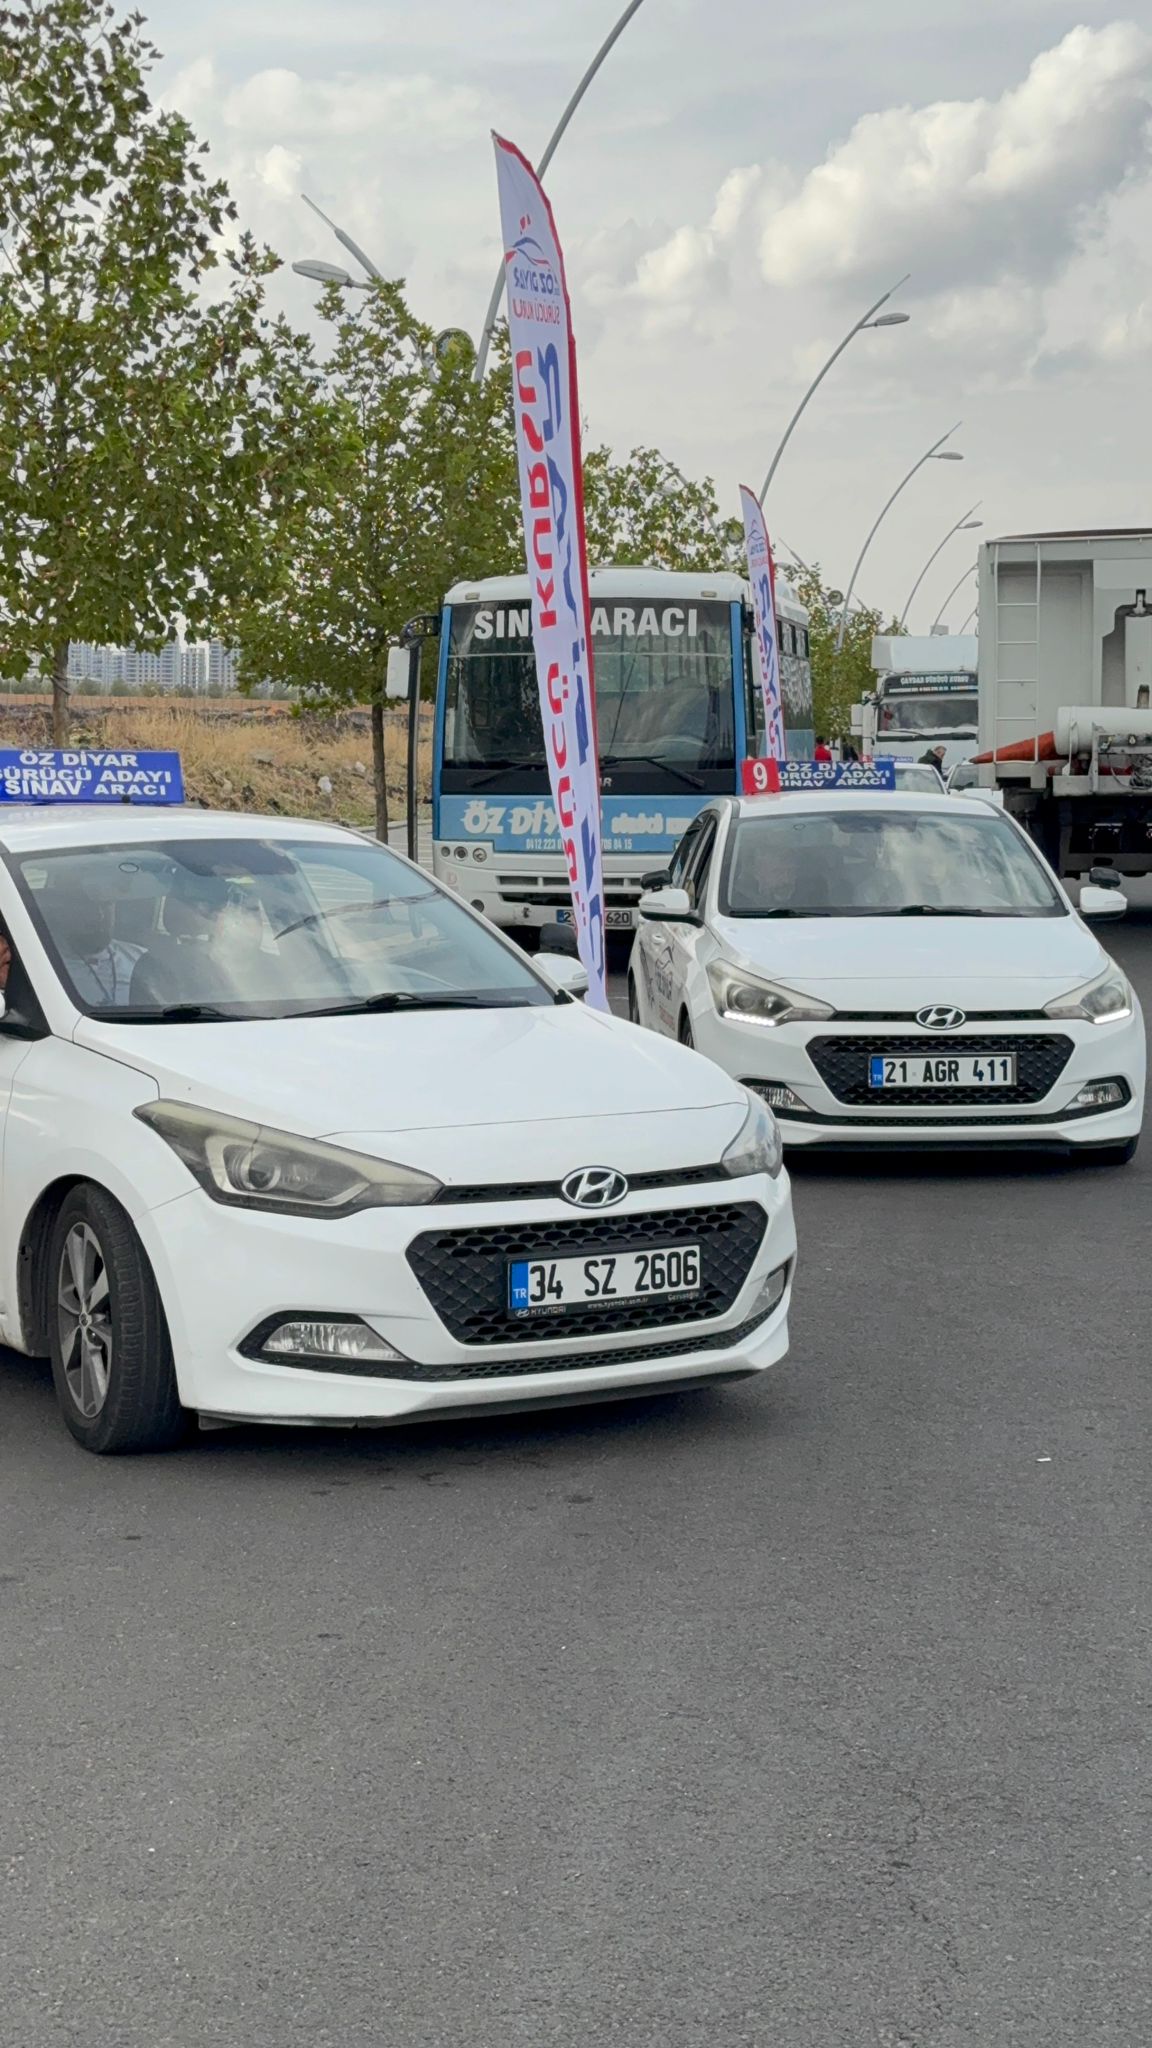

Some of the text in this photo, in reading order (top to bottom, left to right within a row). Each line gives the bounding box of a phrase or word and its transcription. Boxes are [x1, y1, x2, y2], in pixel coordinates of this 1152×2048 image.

[474, 608, 698, 640] SIN ARACI
[20, 751, 138, 767] ÖZ DİYAR
[785, 760, 876, 772] ÖZ DİYAR
[0, 766, 172, 783] ÜRÜCÜ ADAYI
[753, 762, 768, 790] 9
[778, 770, 890, 780] ÜRÜCÜ ADAYI
[835, 778, 886, 786] ARACI
[5, 780, 166, 796] SINAV ARACI
[462, 801, 505, 834] ÖZ
[624, 839, 633, 850] 15
[606, 912, 629, 924] 620
[885, 1061, 907, 1083] 21
[923, 1060, 960, 1083] AGR
[973, 1059, 1008, 1082] 411
[513, 1250, 698, 1302] TR 34 SZ 2606
